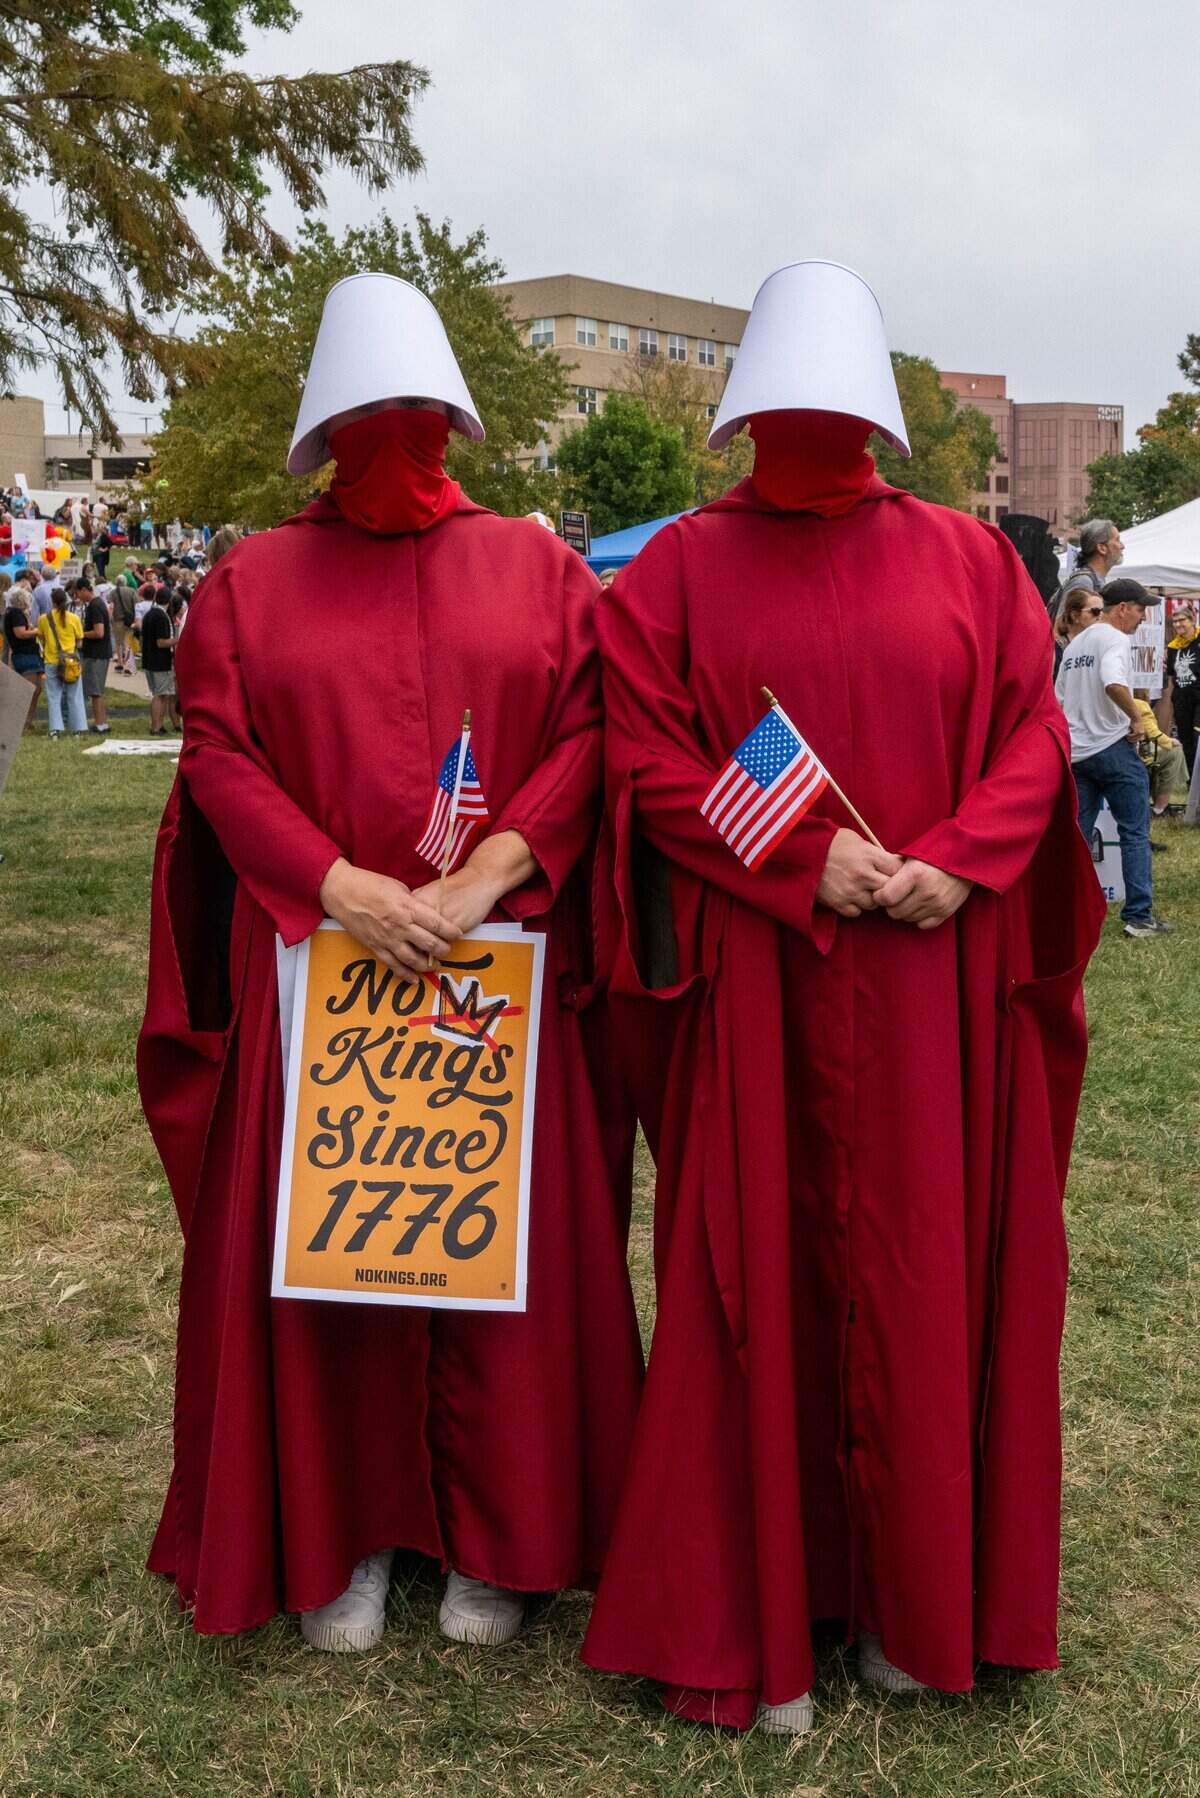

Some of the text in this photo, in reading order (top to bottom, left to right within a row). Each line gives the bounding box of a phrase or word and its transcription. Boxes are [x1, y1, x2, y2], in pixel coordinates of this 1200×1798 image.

[325, 953, 494, 1016] No
[309, 1025, 514, 1109] Kings
[307, 1104, 508, 1174] Since
[306, 1179, 500, 1260] 1776
[354, 1268, 448, 1287] NOKINGS.ORG
